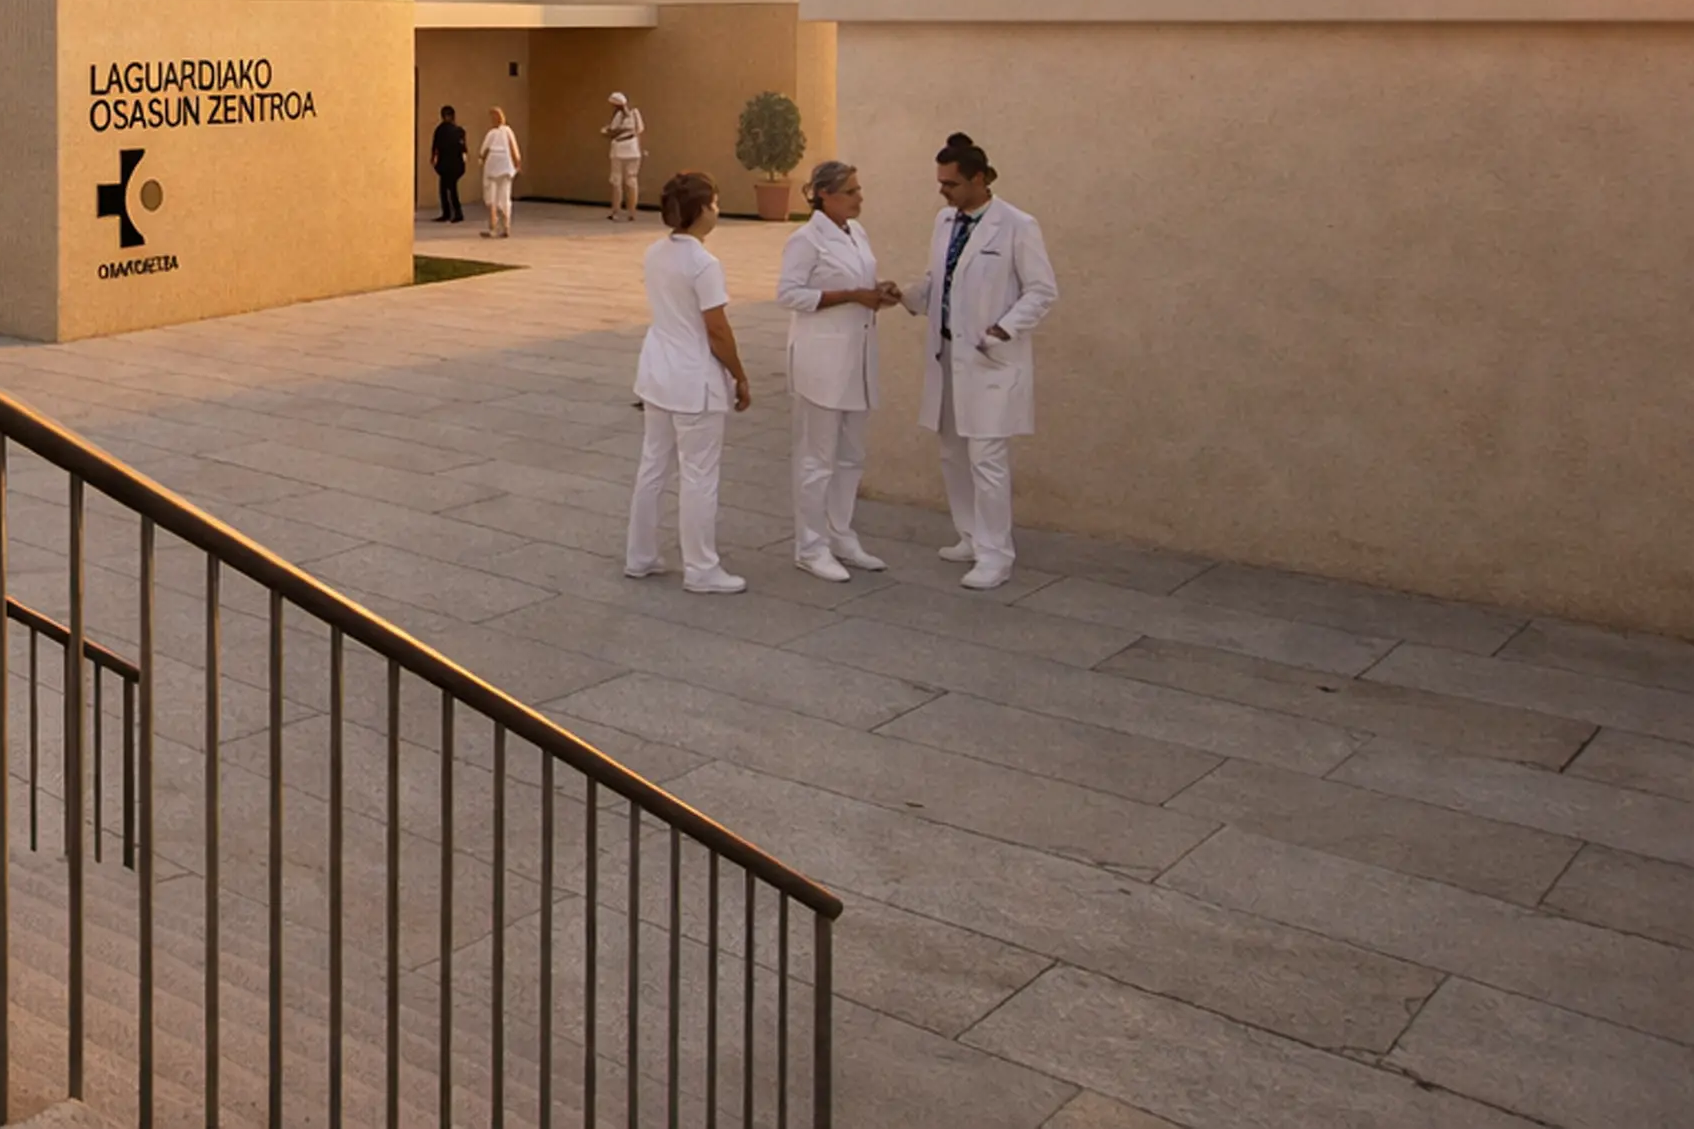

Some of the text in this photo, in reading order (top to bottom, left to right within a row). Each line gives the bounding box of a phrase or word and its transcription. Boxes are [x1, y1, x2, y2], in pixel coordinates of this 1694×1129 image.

[90, 59, 272, 95] LAGUARDIAKO
[89, 91, 317, 132] OSASUN ZENTROA
